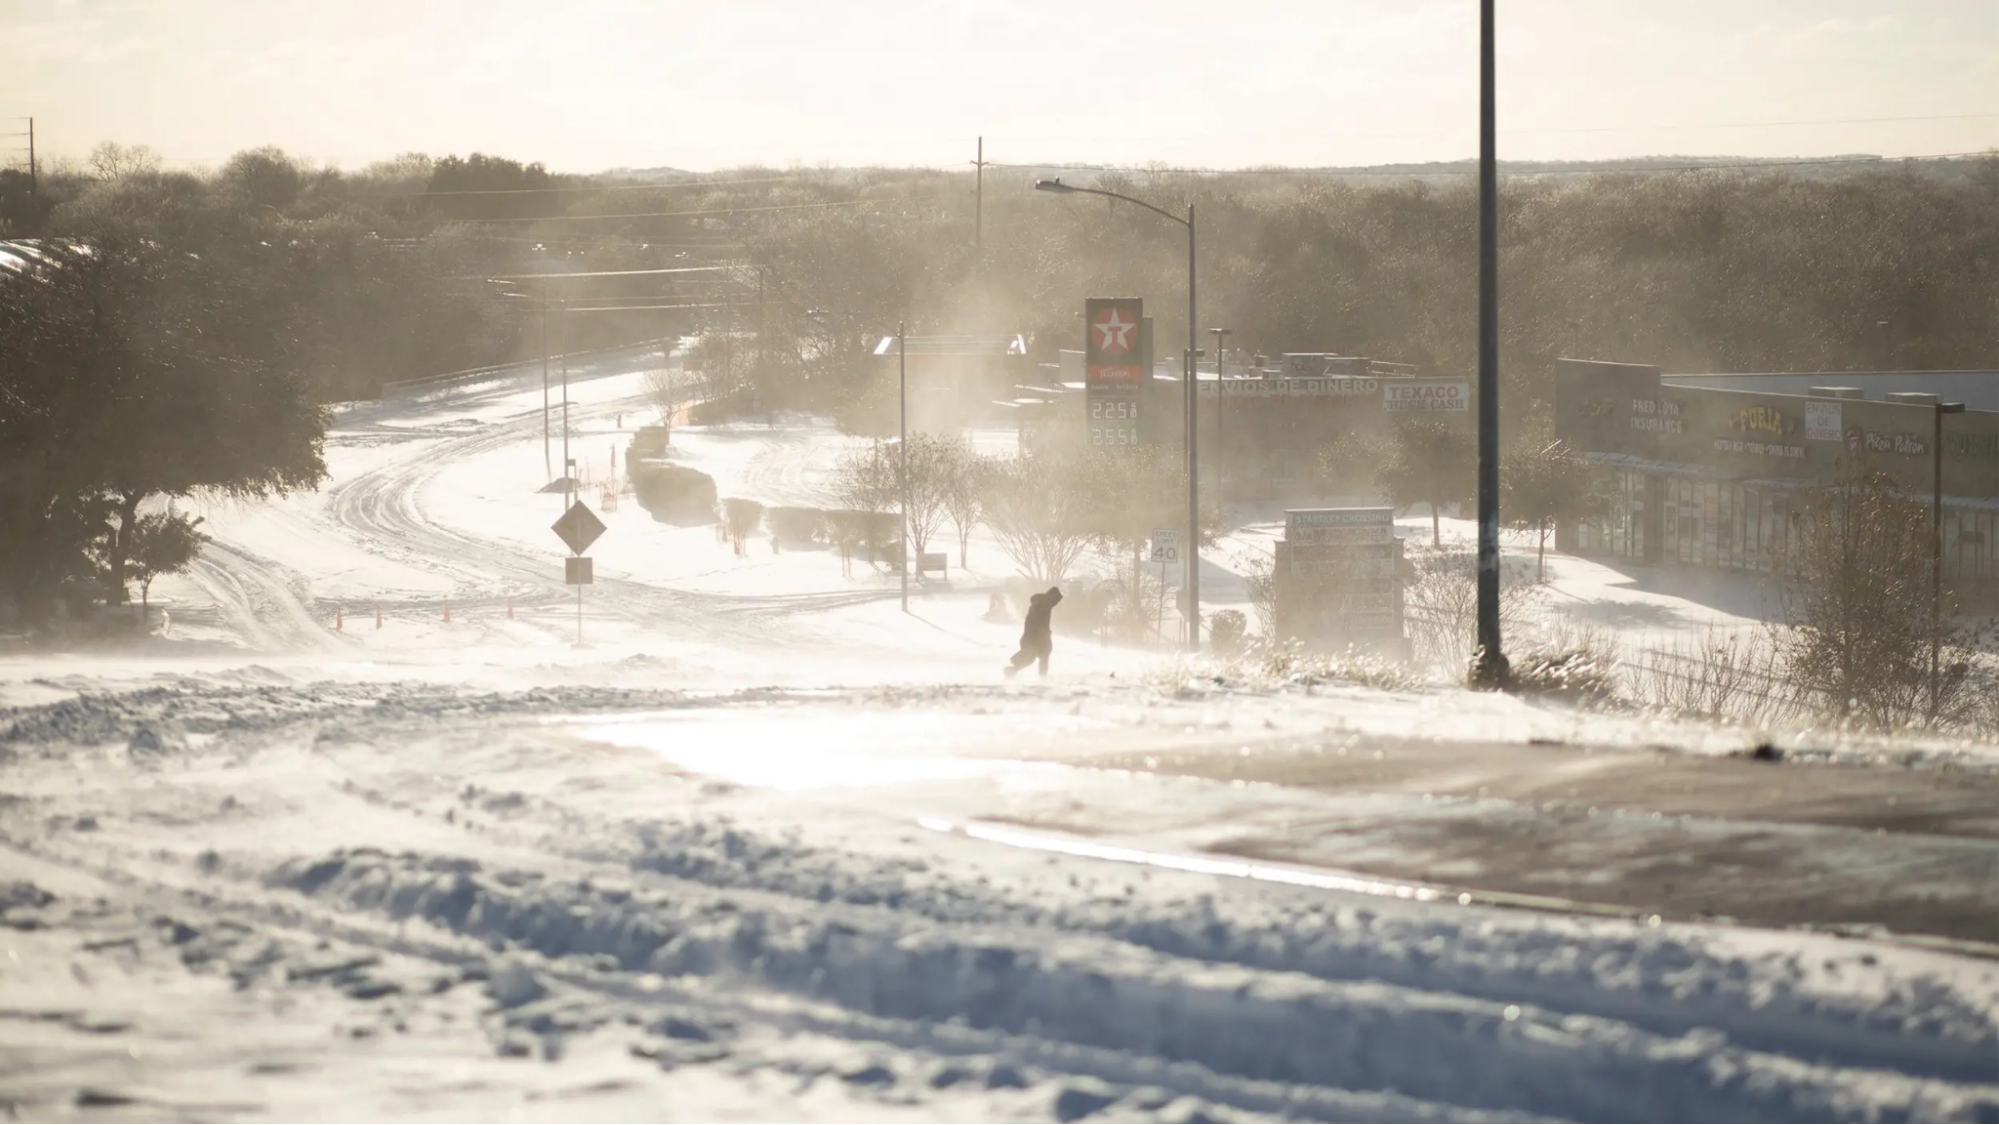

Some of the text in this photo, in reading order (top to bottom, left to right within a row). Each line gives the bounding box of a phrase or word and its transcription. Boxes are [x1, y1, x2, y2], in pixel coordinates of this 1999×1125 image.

[1199, 379, 1378, 393] ENVIOS DE DINERO
[1388, 386, 1459, 399] TEXACO
[1430, 399, 1465, 410] CASH
[1633, 400, 1679, 415] FRED LOYA
[1807, 403, 1840, 414] ENVIOS
[1631, 417, 1682, 433] INSURANCE
[1740, 407, 1782, 435] FURIA
[1817, 416, 1831, 426] DE
[1806, 427, 1840, 439] DINERO
[1866, 432, 1891, 451] Pizza
[1342, 513, 1389, 523] CROSSING
[1153, 546, 1177, 560] 40
